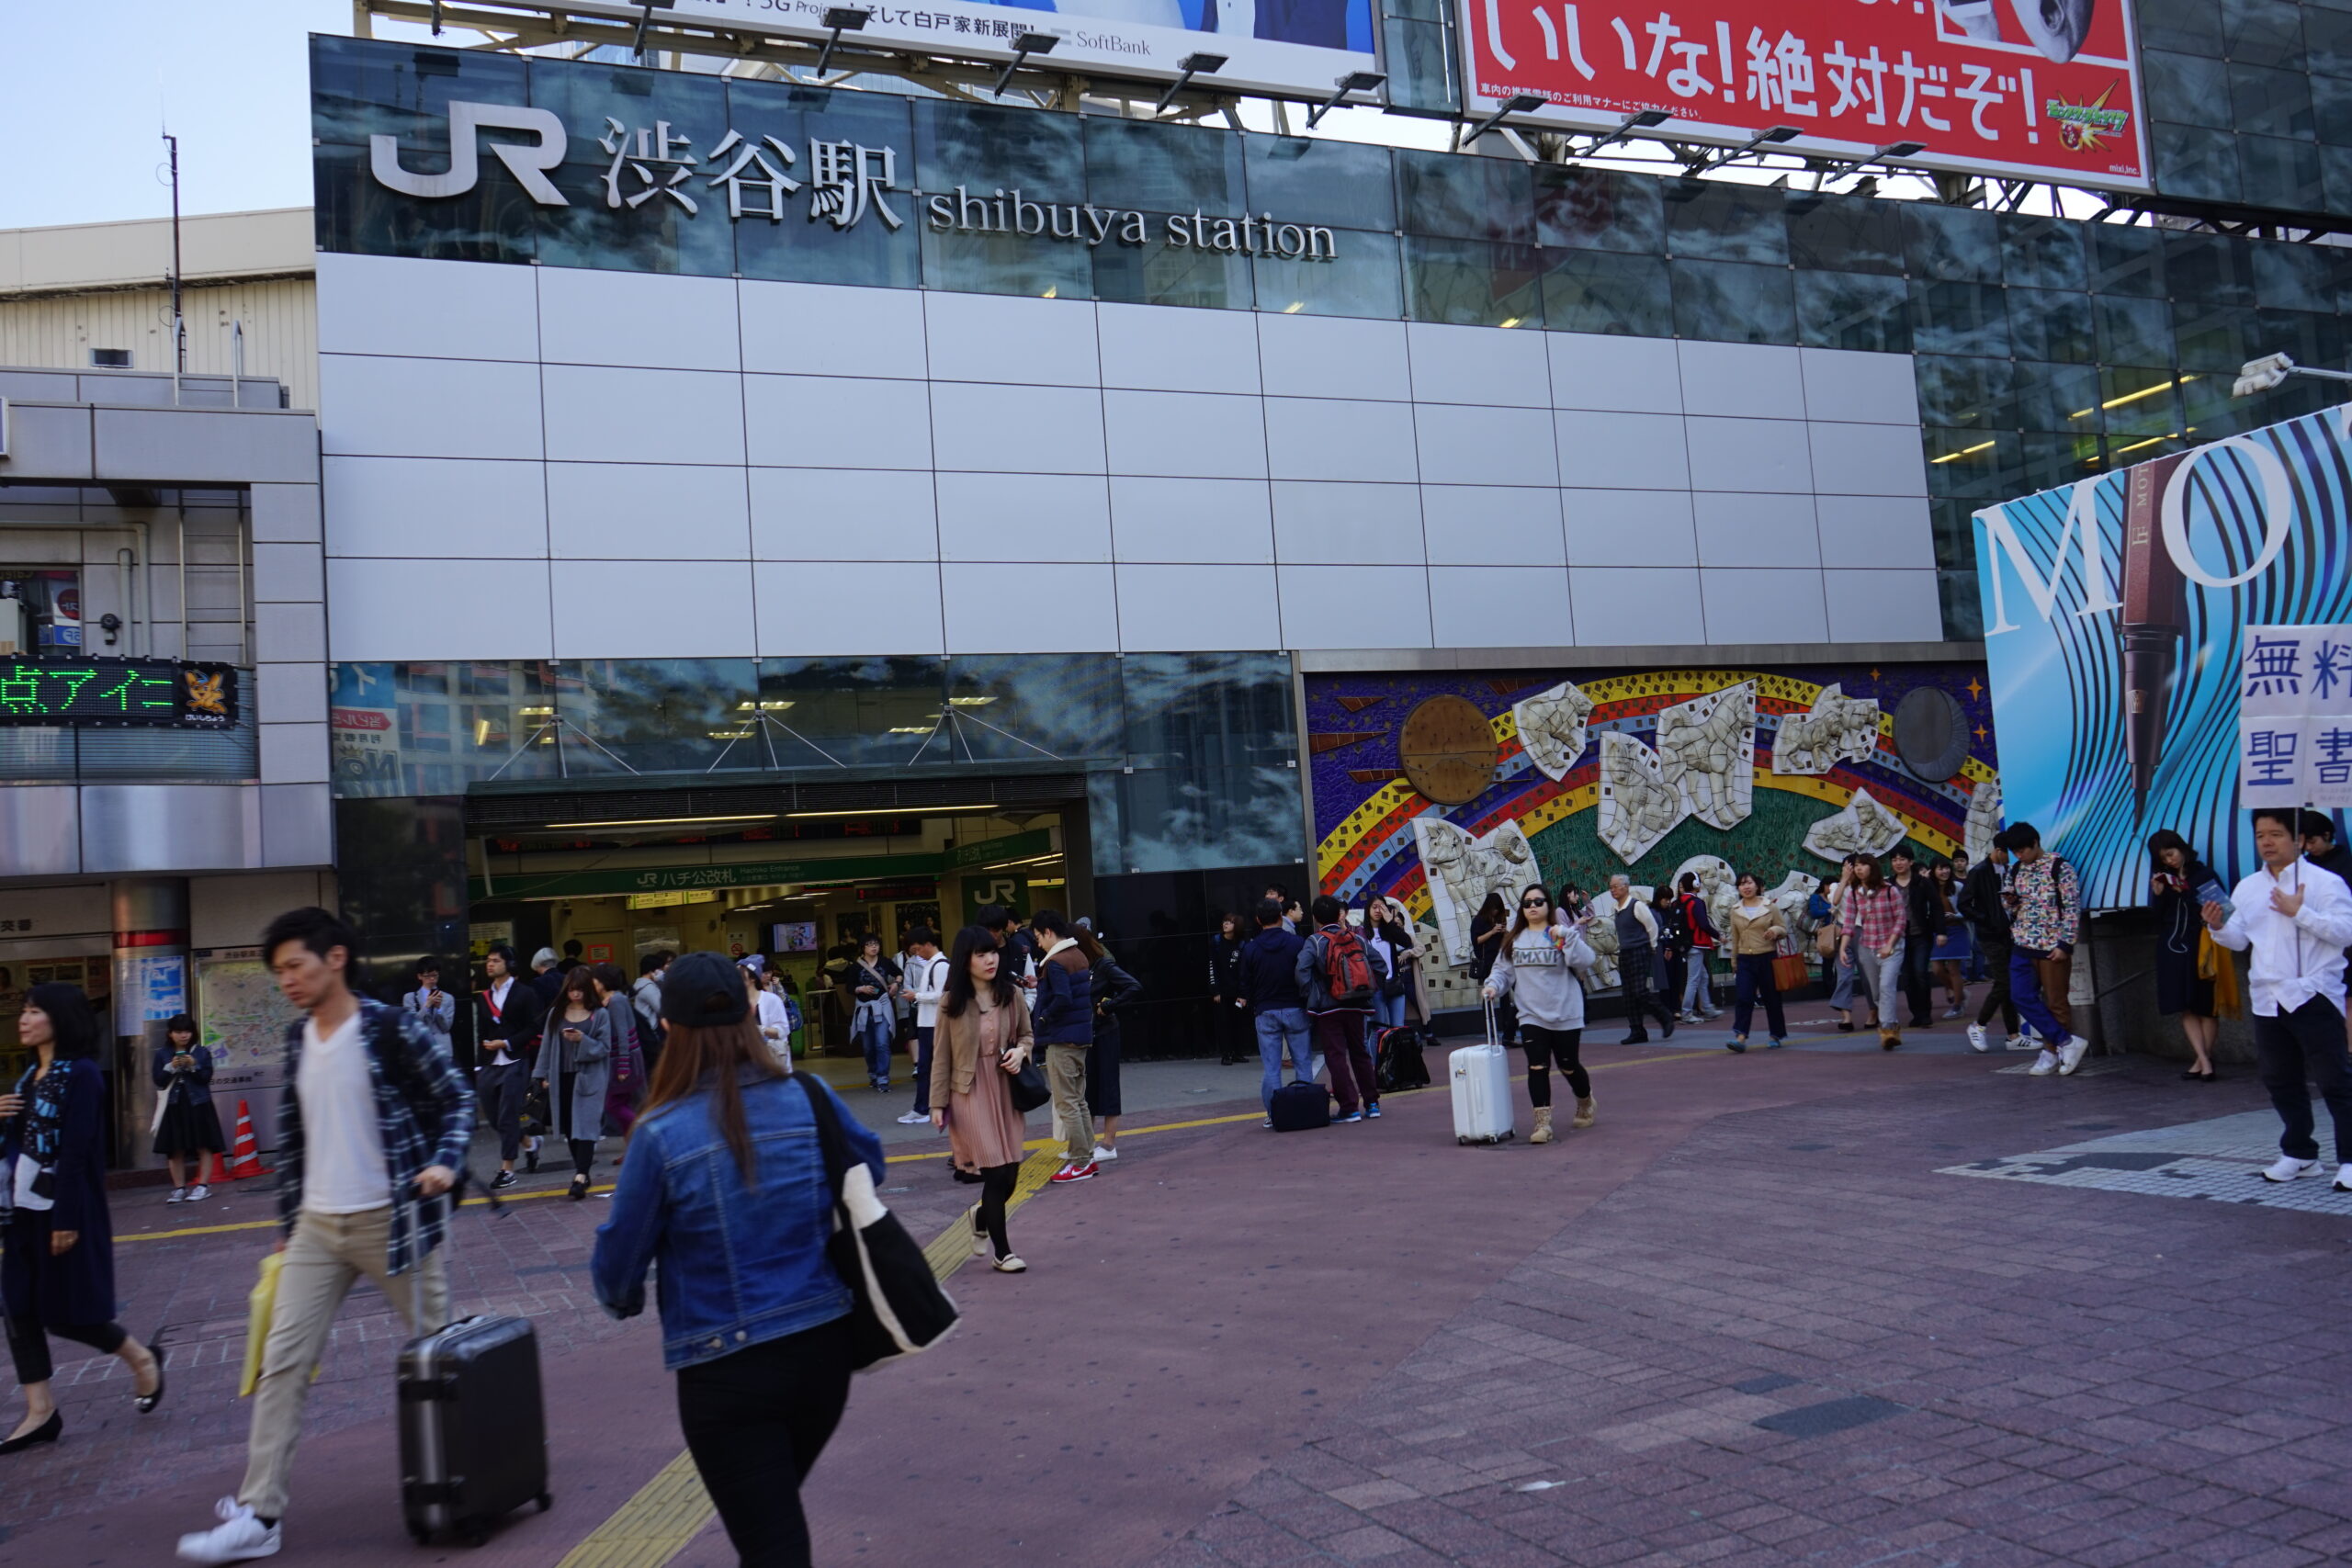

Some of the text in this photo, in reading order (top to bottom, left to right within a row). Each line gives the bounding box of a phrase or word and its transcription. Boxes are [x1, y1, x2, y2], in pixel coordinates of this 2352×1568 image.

[1076, 30, 1152, 57] SoftBank
[369, 100, 1338, 260] JR 渋谷駅 shibuya station
[2245, 635, 2352, 700] 無料
[2247, 727, 2352, 786] 聖書
[637, 873, 658, 885] JR
[662, 868, 737, 886] ハチ公改札
[974, 879, 1017, 905] JR
